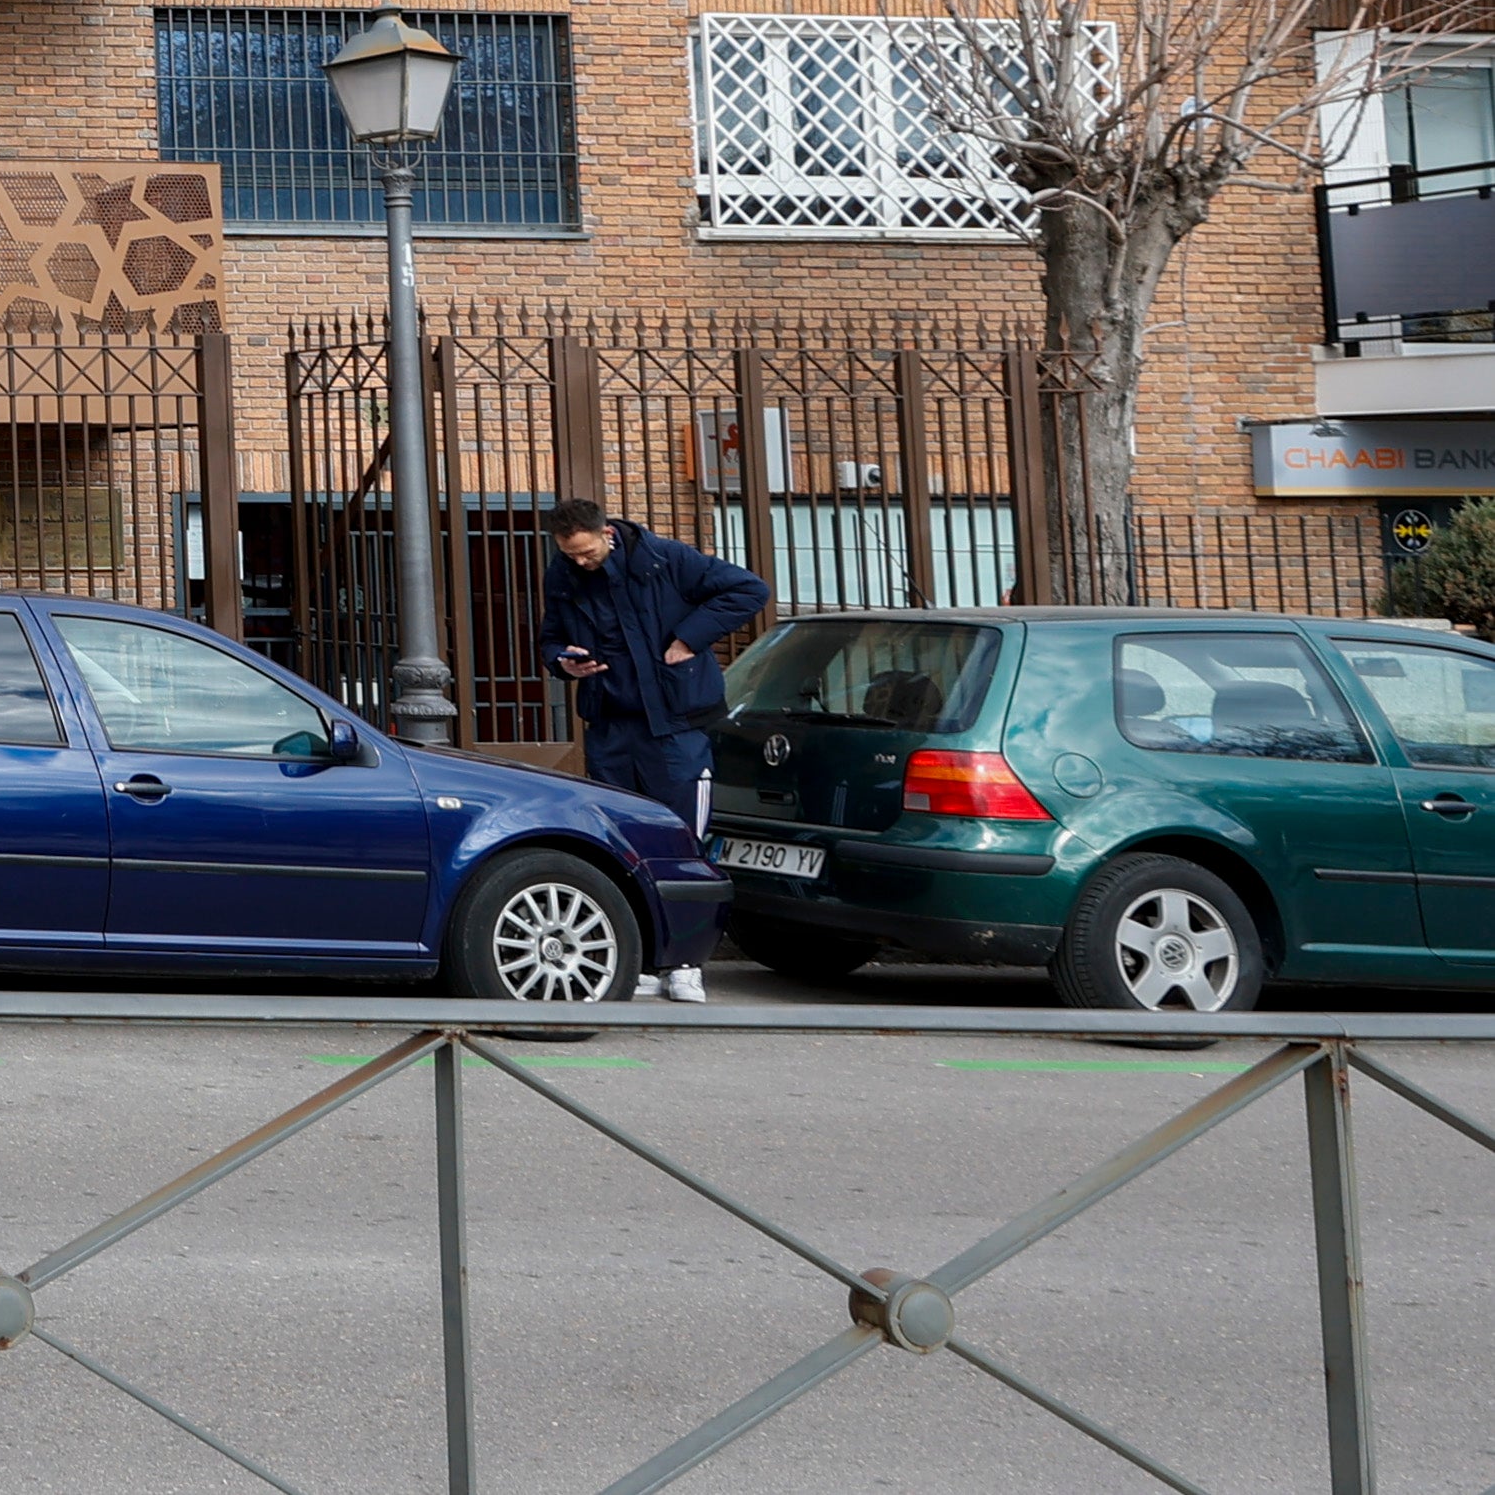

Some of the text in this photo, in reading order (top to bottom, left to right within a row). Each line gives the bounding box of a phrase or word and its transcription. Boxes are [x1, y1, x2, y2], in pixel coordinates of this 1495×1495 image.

[1284, 447, 1495, 471] CHAABI BANK
[720, 841, 823, 873] M 2190 YV
